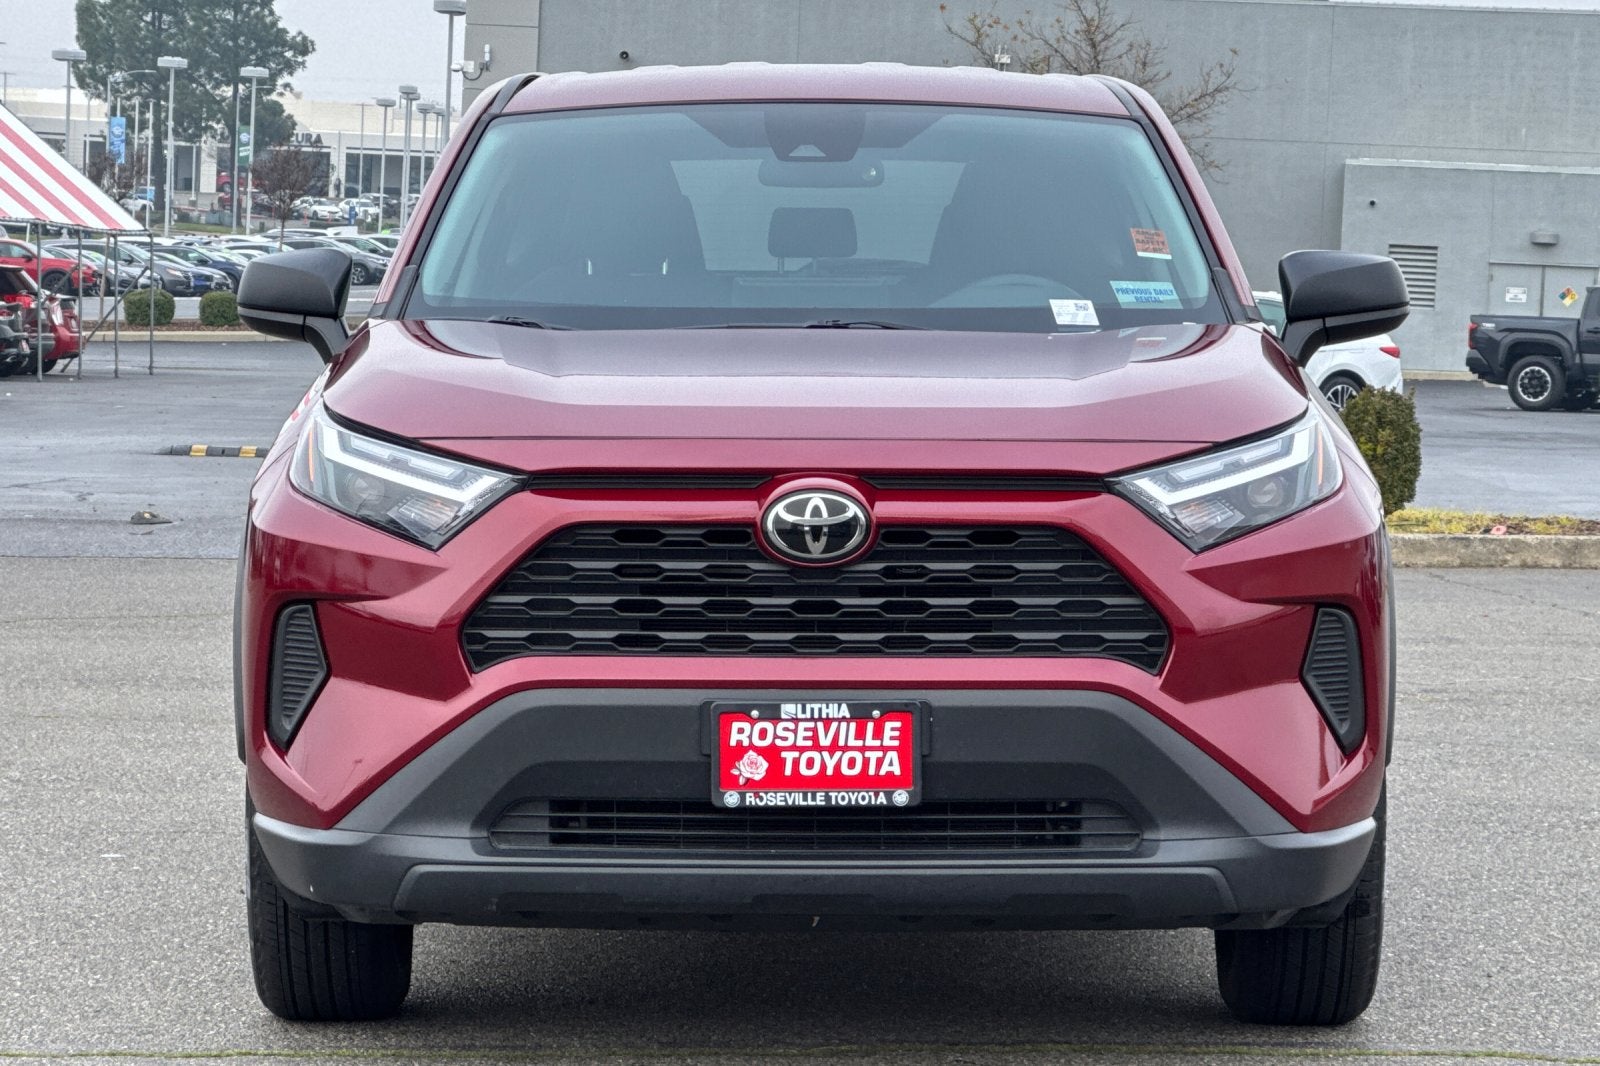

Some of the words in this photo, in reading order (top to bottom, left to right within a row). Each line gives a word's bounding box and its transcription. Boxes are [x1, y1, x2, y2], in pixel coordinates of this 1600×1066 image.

[290, 132, 323, 145] URA
[1115, 287, 1152, 296] PREVIOUS
[1153, 288, 1174, 296] DAILY
[1134, 295, 1162, 303] RENTAL
[797, 703, 851, 719] LITHIA
[729, 721, 902, 747] ROSEVILLE
[780, 750, 902, 776] TOYOTA
[745, 791, 826, 806] ROSEVILLE
[831, 791, 887, 805] TOYOTA
